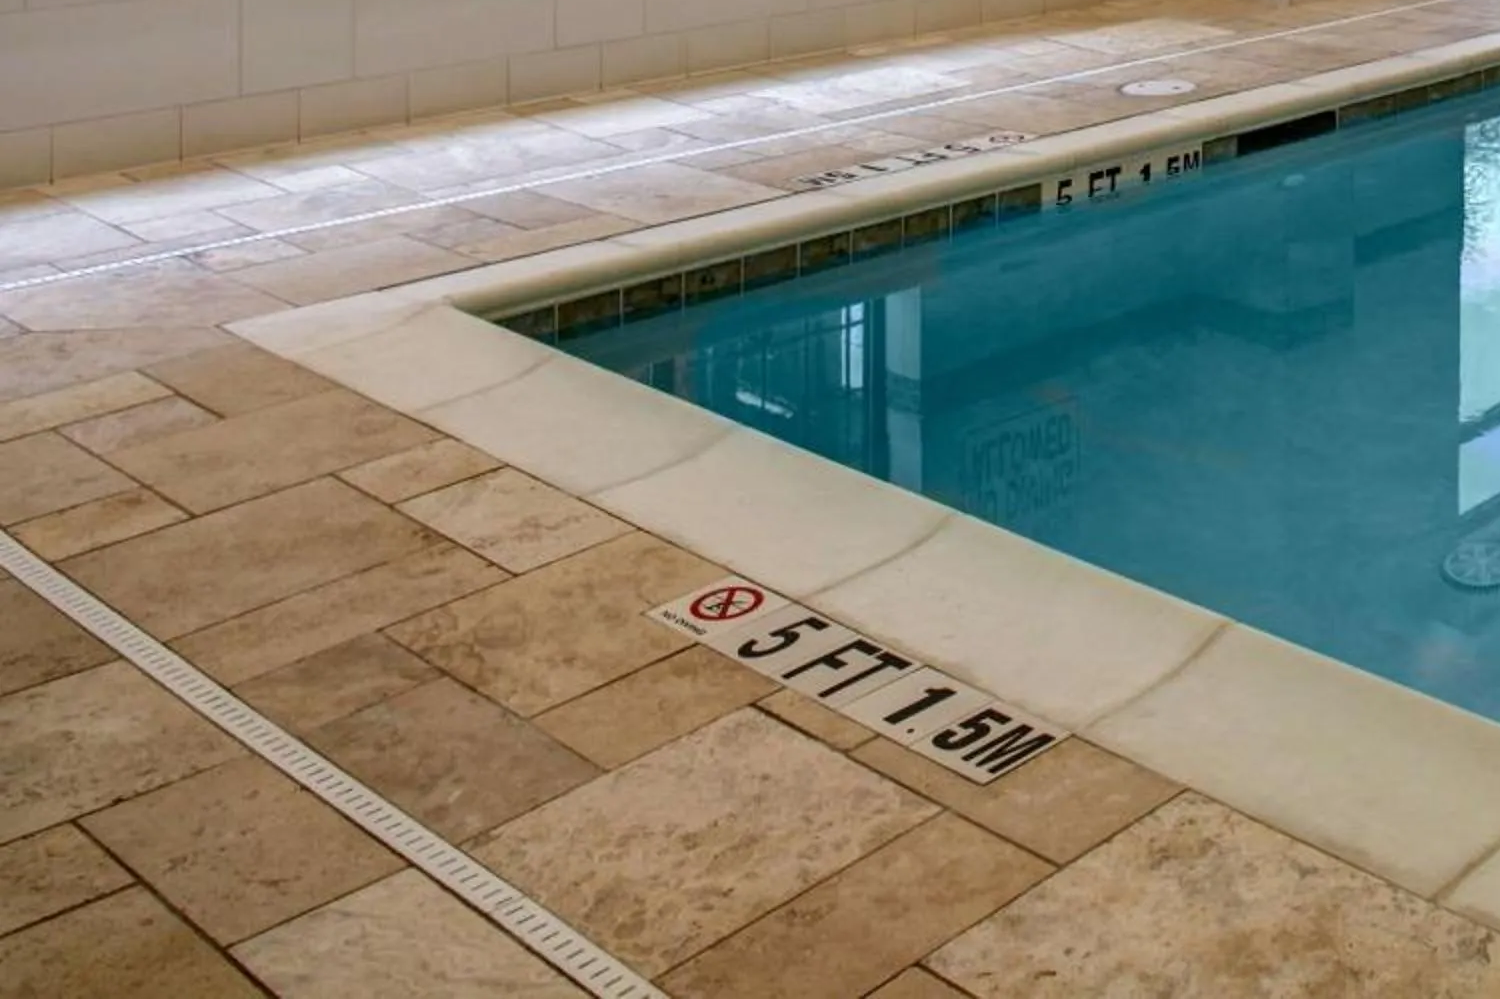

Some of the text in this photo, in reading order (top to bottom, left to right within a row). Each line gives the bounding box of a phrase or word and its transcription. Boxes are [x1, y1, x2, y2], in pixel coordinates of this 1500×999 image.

[1056, 179, 1073, 206] 5
[1088, 166, 1122, 198] FT
[737, 616, 1058, 774] 5 FT 1.5M
